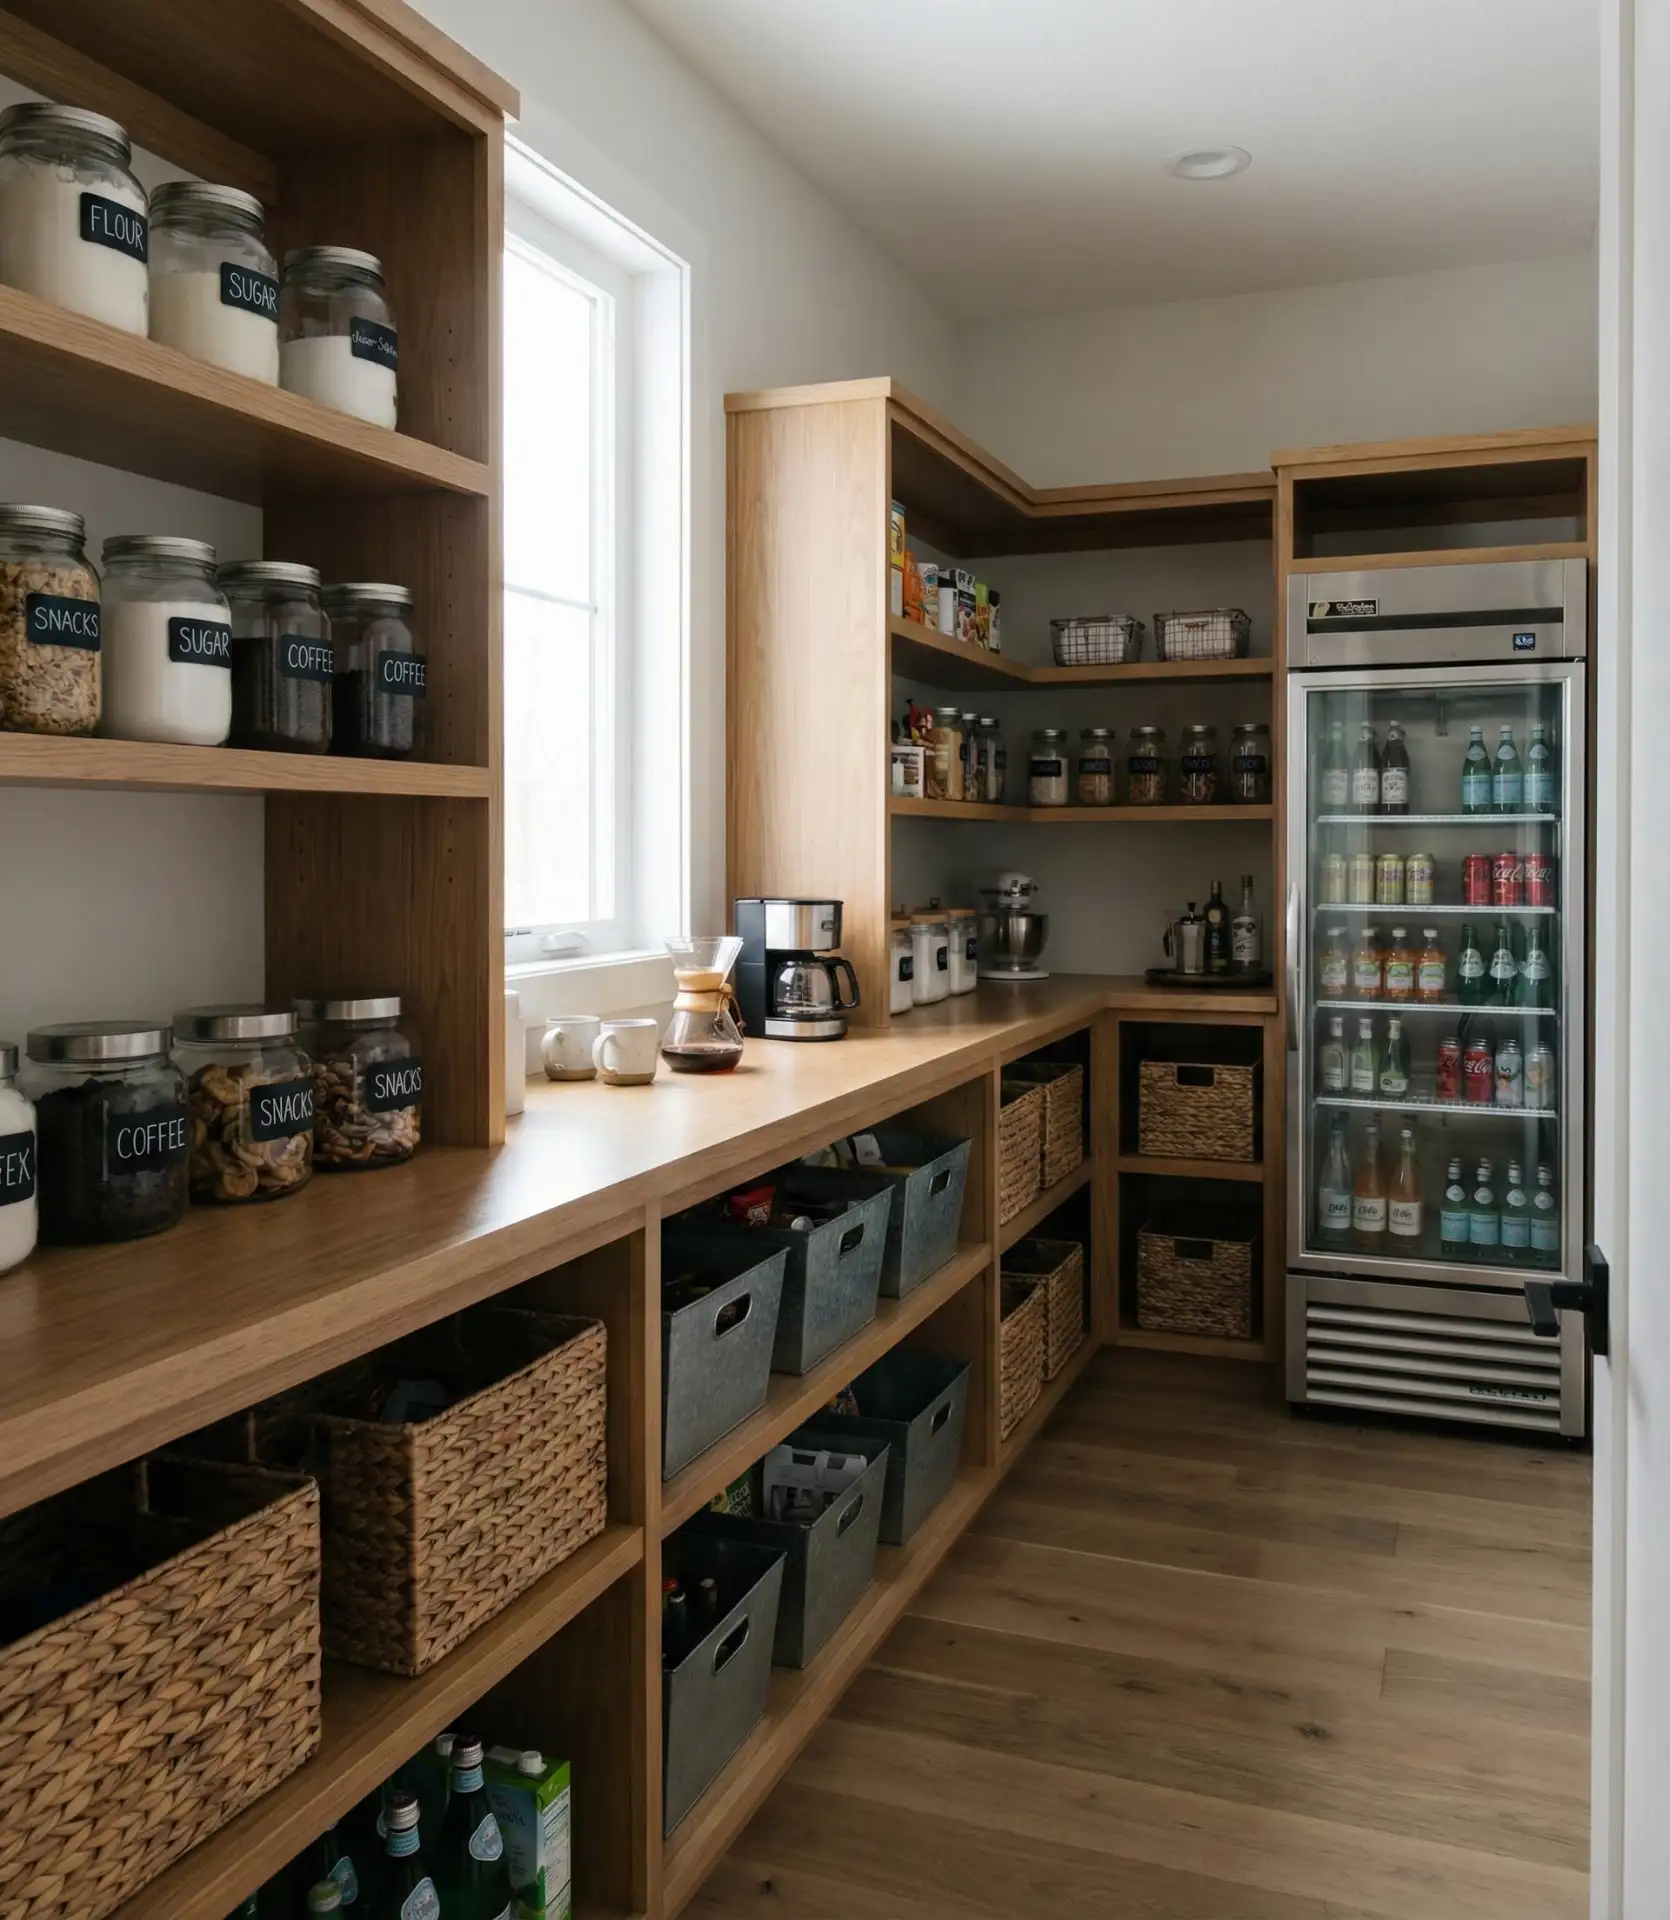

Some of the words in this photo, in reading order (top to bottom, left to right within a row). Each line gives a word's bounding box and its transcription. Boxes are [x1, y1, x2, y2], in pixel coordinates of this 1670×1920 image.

[90, 204, 143, 251] FLOUR
[229, 272, 277, 312] SUGAR
[35, 606, 98, 637] SNACKS
[179, 626, 229, 656] SUGAR
[288, 643, 334, 673] COFFEE
[384, 659, 425, 686] COFFEE
[375, 1067, 422, 1099] SNACKS
[260, 1088, 313, 1127] SNACKS
[117, 1117, 185, 1159] COFFEE
